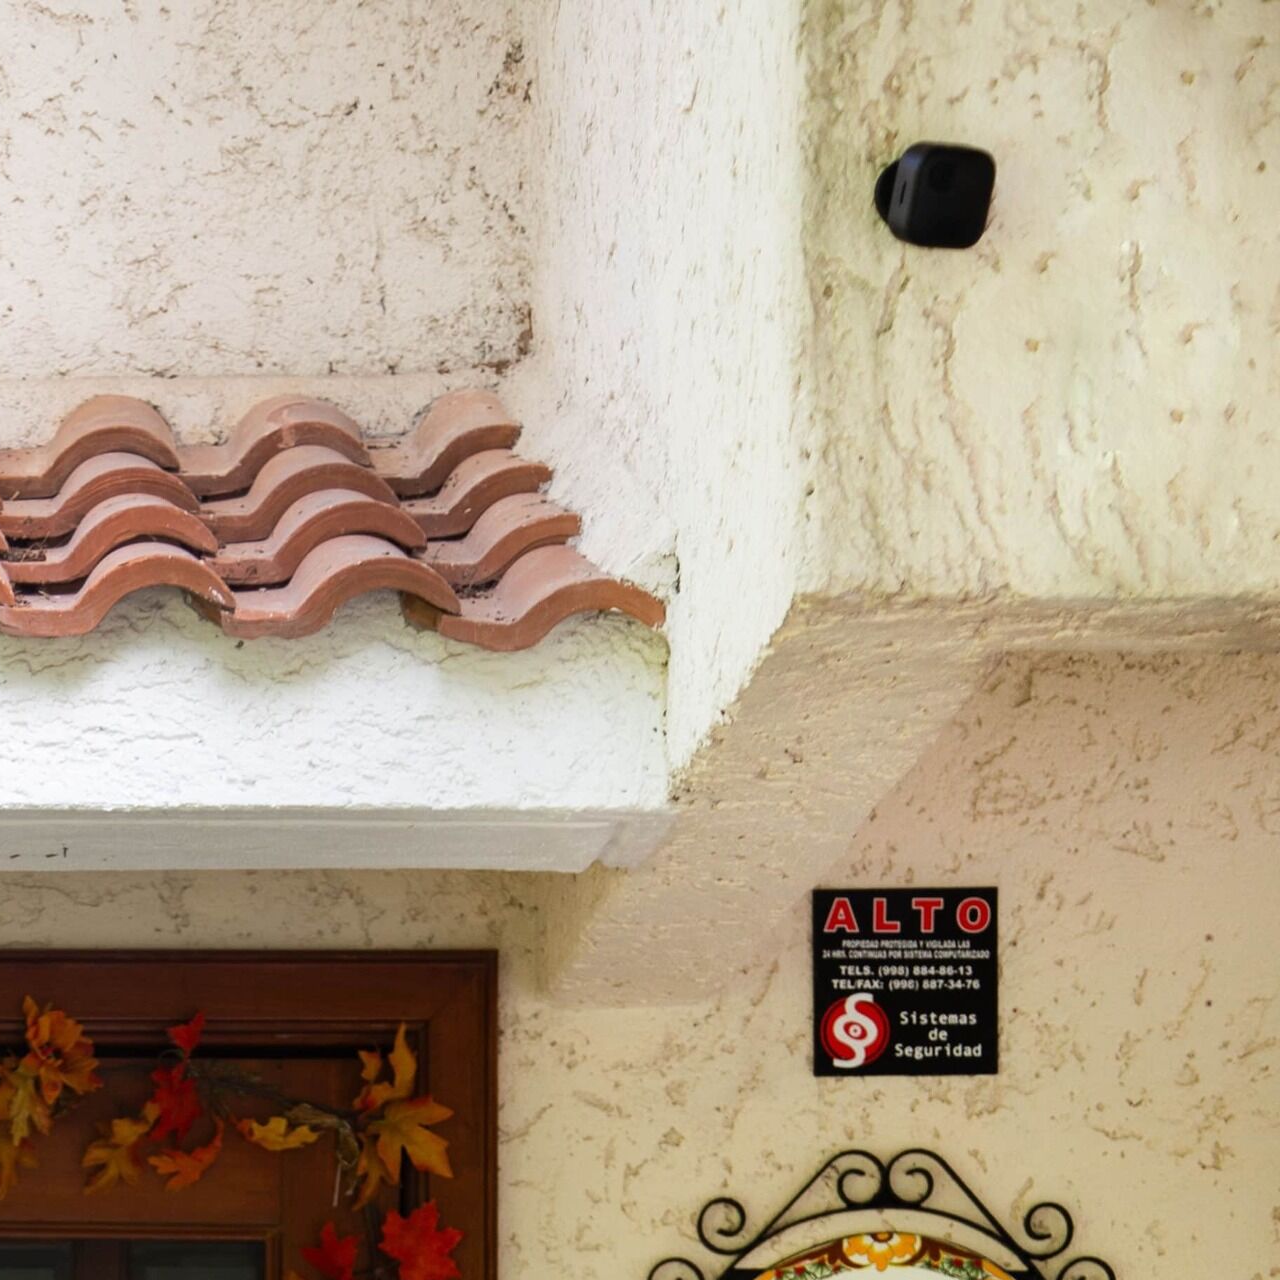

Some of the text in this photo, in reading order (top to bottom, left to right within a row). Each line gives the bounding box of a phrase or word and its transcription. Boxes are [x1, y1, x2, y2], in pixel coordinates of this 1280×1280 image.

[823, 896, 991, 933] ALTO
[839, 965, 874, 976] TELS.
[878, 965, 910, 977] (998)
[831, 979, 884, 990] TEL/FAX:
[888, 979, 919, 991] (998)
[899, 1011, 977, 1026] Sistemas
[928, 1028, 948, 1041] de
[894, 1043, 983, 1059] Seguridad
